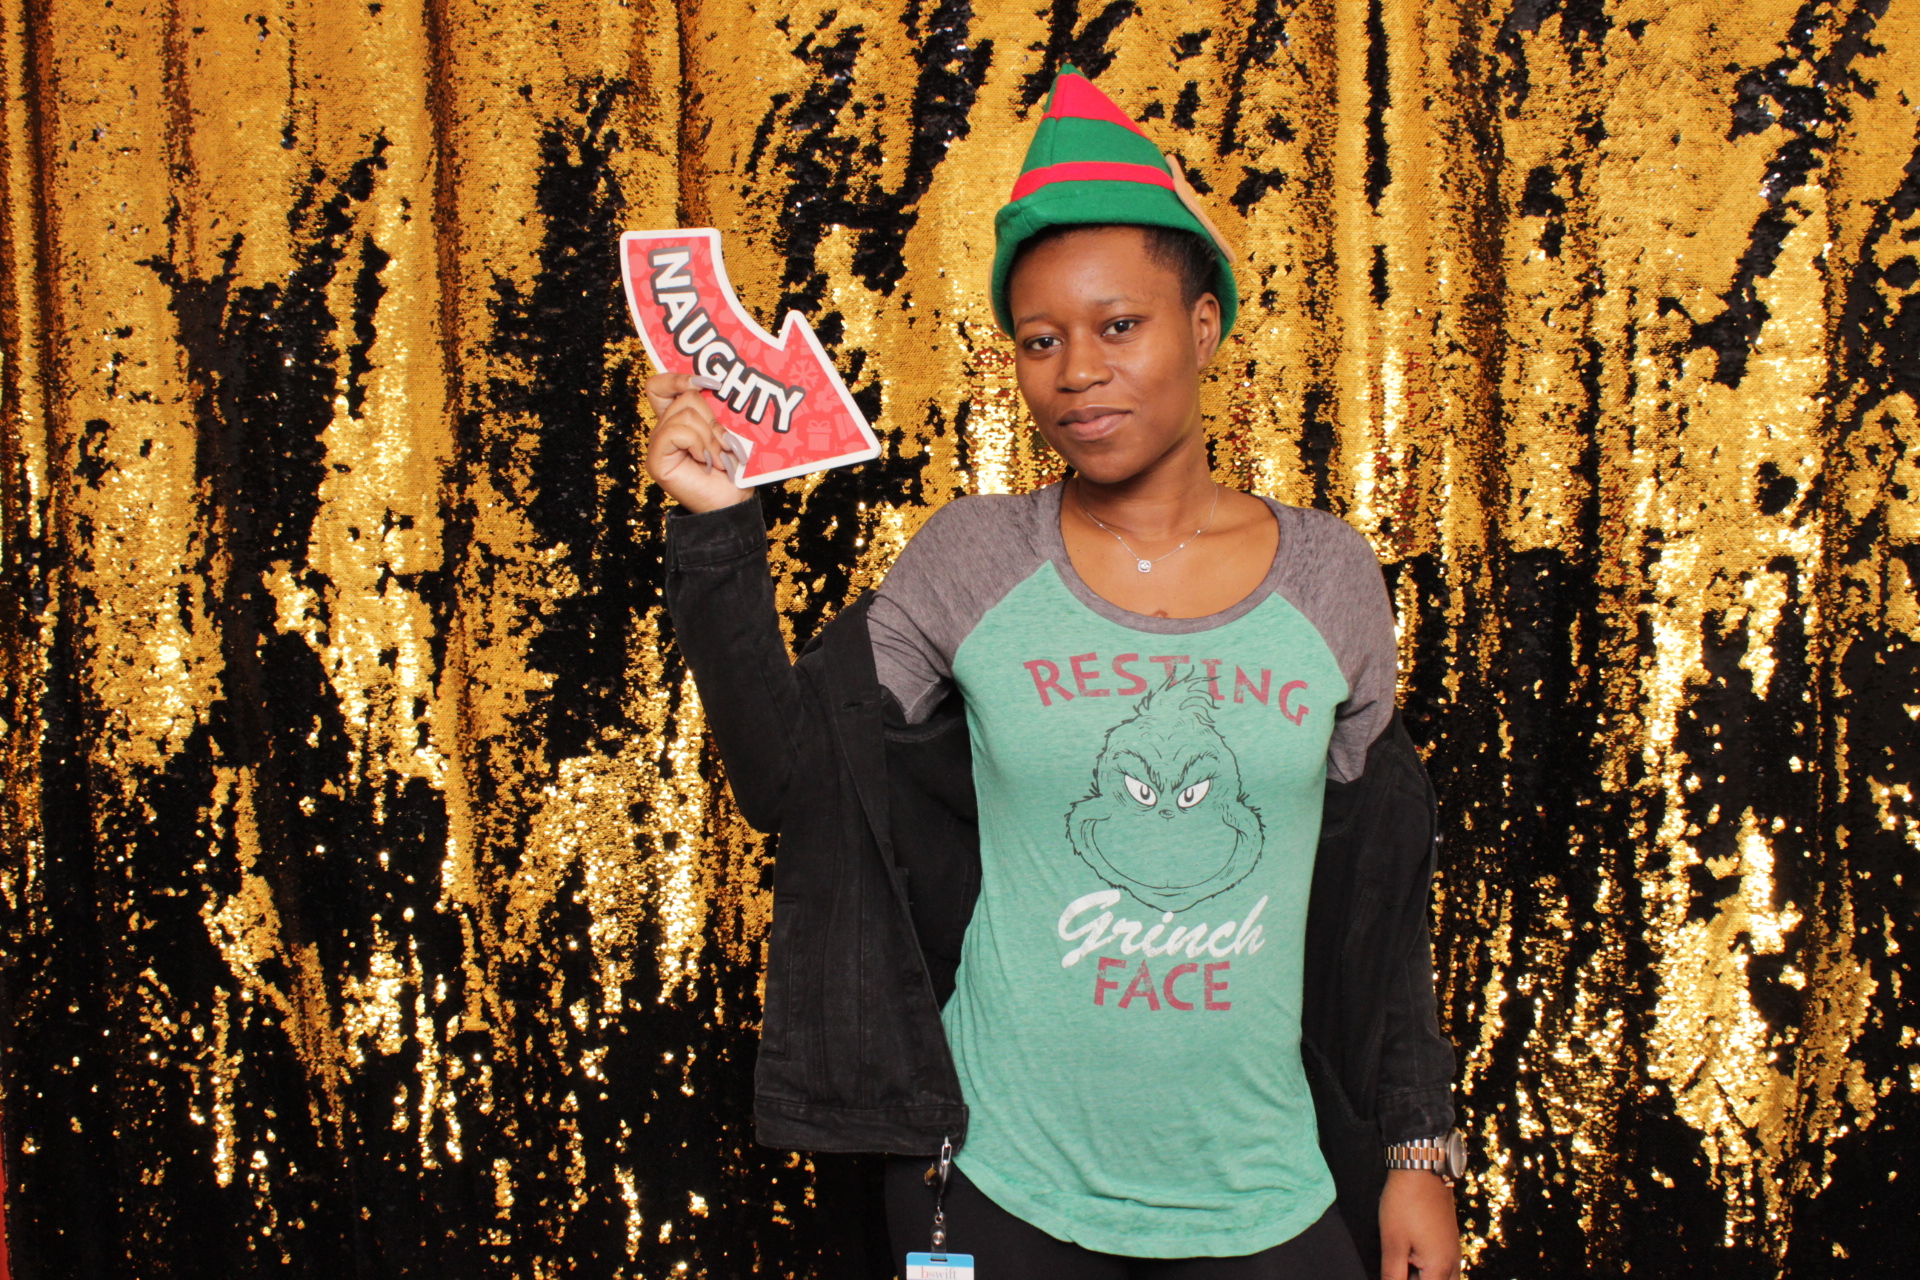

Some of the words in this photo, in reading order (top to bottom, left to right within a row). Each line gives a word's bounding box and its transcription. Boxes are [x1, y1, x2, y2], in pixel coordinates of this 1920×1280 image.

[649, 246, 806, 434] NAUGHTY
[1023, 652, 1310, 726] RESTING
[1058, 889, 1269, 968] Grinch
[1093, 956, 1232, 1011] FACE
[921, 1266, 956, 1279] bswift
